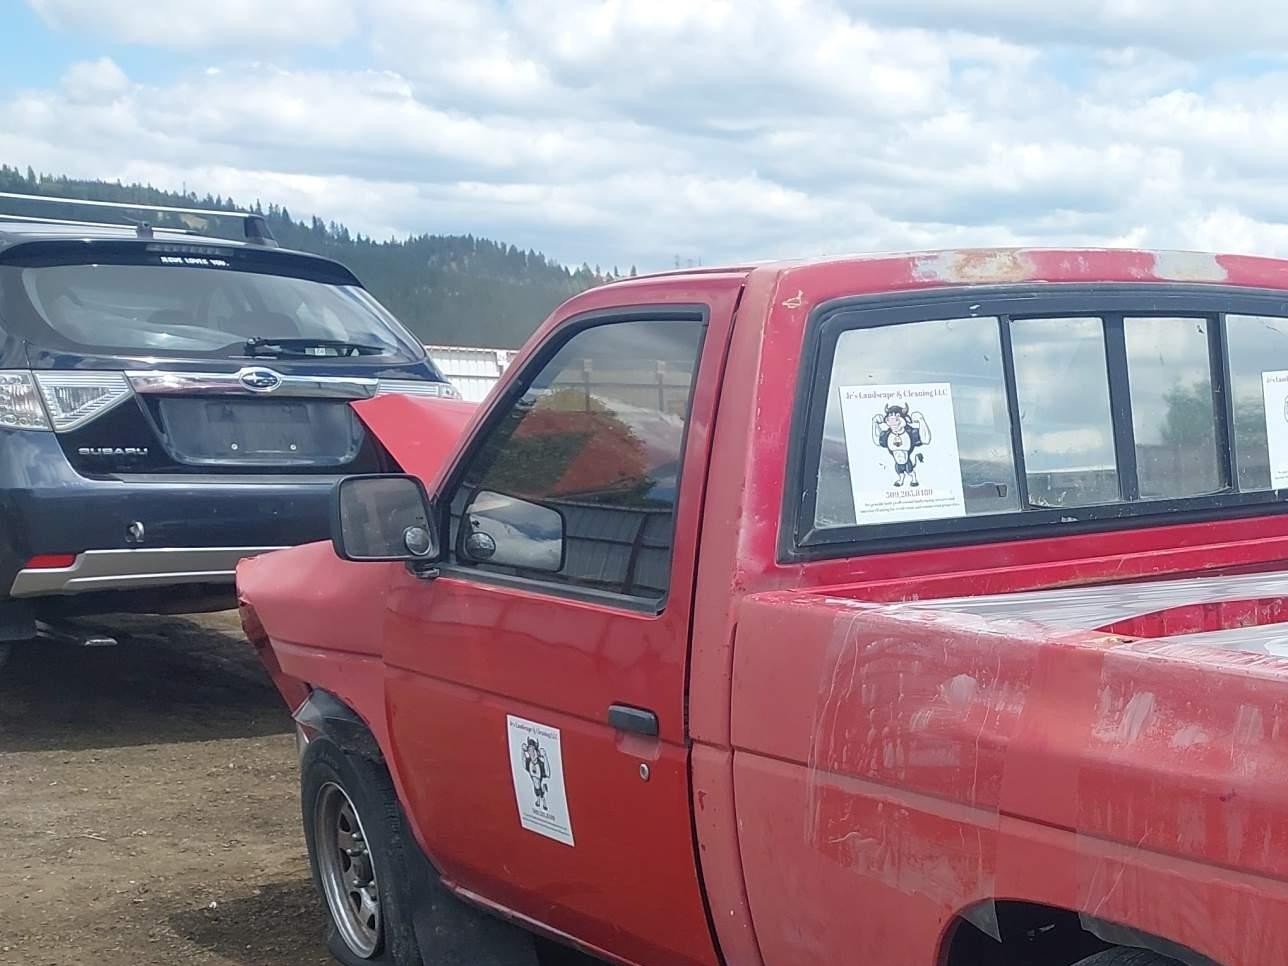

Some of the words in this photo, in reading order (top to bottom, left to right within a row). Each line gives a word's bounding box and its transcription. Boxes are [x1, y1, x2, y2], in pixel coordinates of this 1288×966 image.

[858, 390, 895, 401] Landscape
[903, 389, 933, 400] Cleaning
[78, 447, 149, 456] SUBARU
